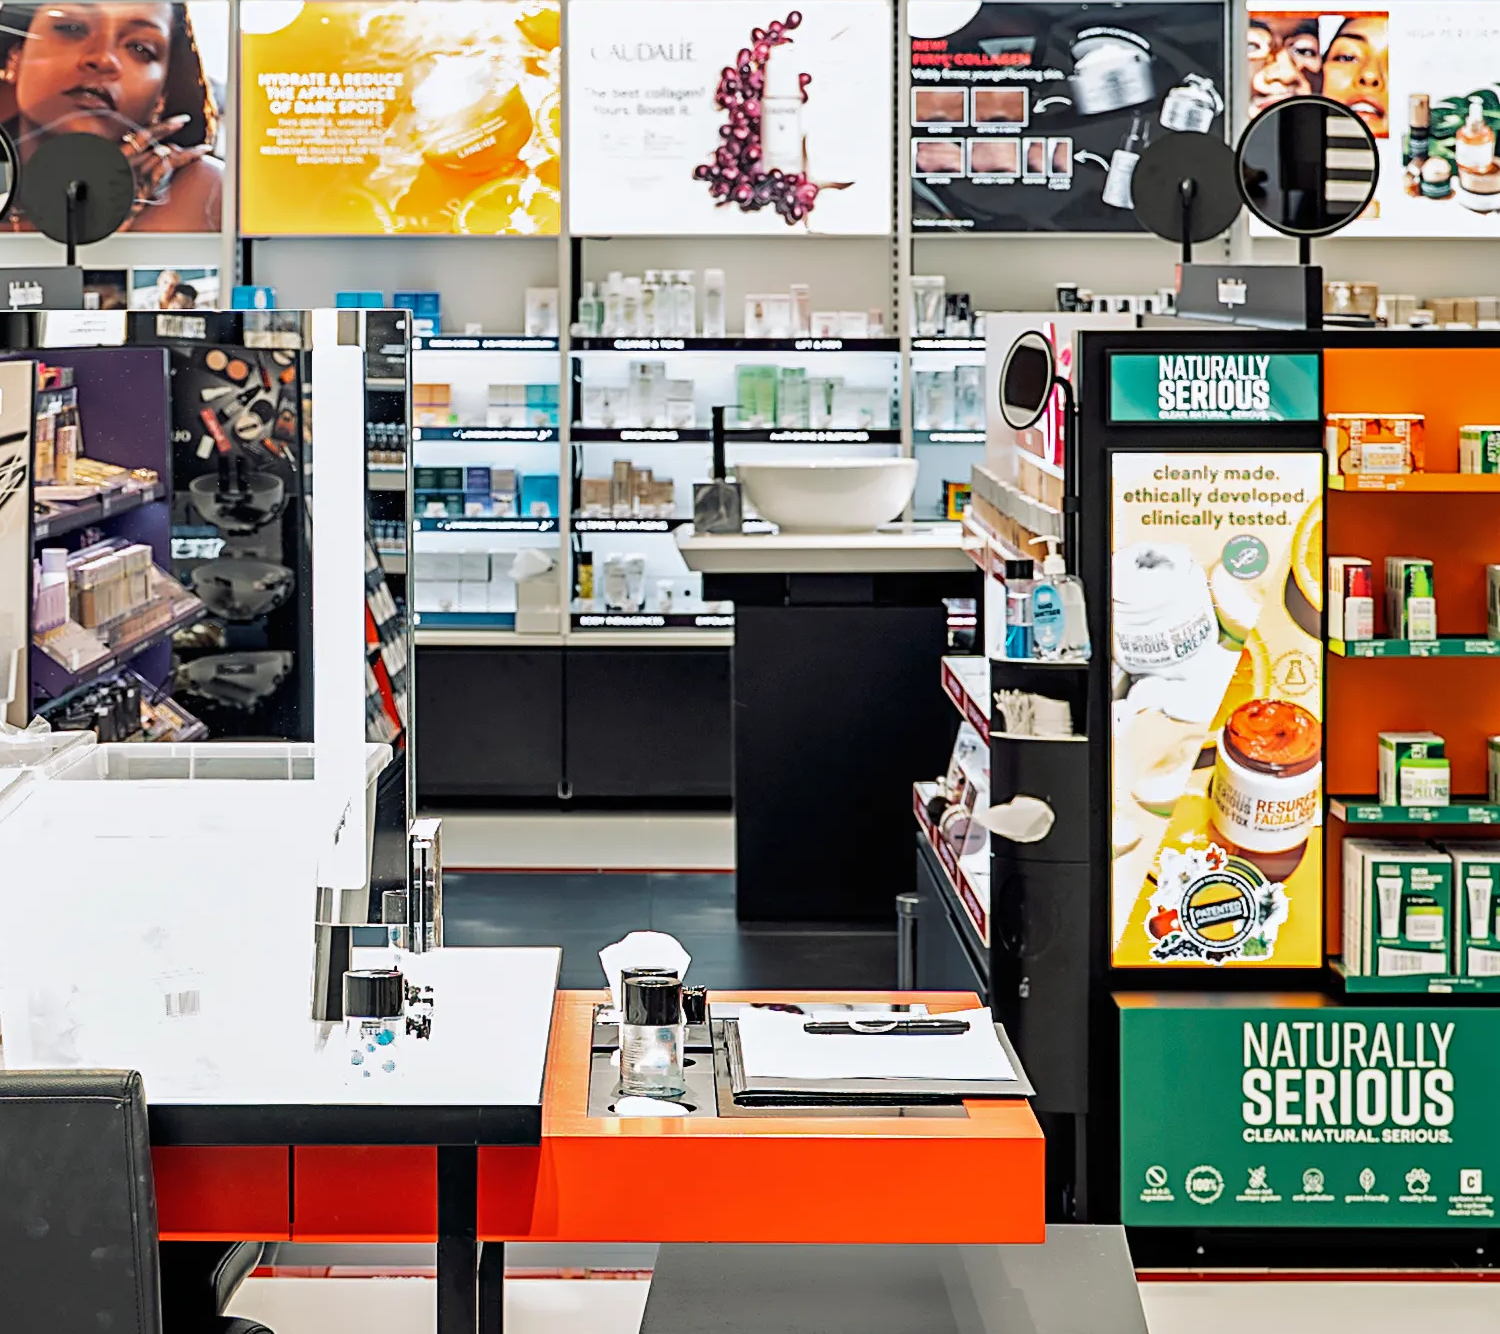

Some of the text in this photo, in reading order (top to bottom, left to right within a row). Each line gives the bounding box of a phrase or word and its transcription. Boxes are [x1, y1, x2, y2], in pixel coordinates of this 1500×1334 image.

[1158, 354, 1270, 380] NATURALLY
[1158, 379, 1270, 410] SERIOUS
[1153, 465, 1280, 484] cleanly made.
[1123, 487, 1311, 507] ethically developed.
[1141, 510, 1292, 530] clinically tested.
[1242, 1022, 1455, 1068] NATURALLY
[1242, 1069, 1455, 1126] SERIOUS
[1242, 1128, 1454, 1143] CLEAN. NATURAL. SERIOUS.
[1191, 1178, 1218, 1192] 100%
